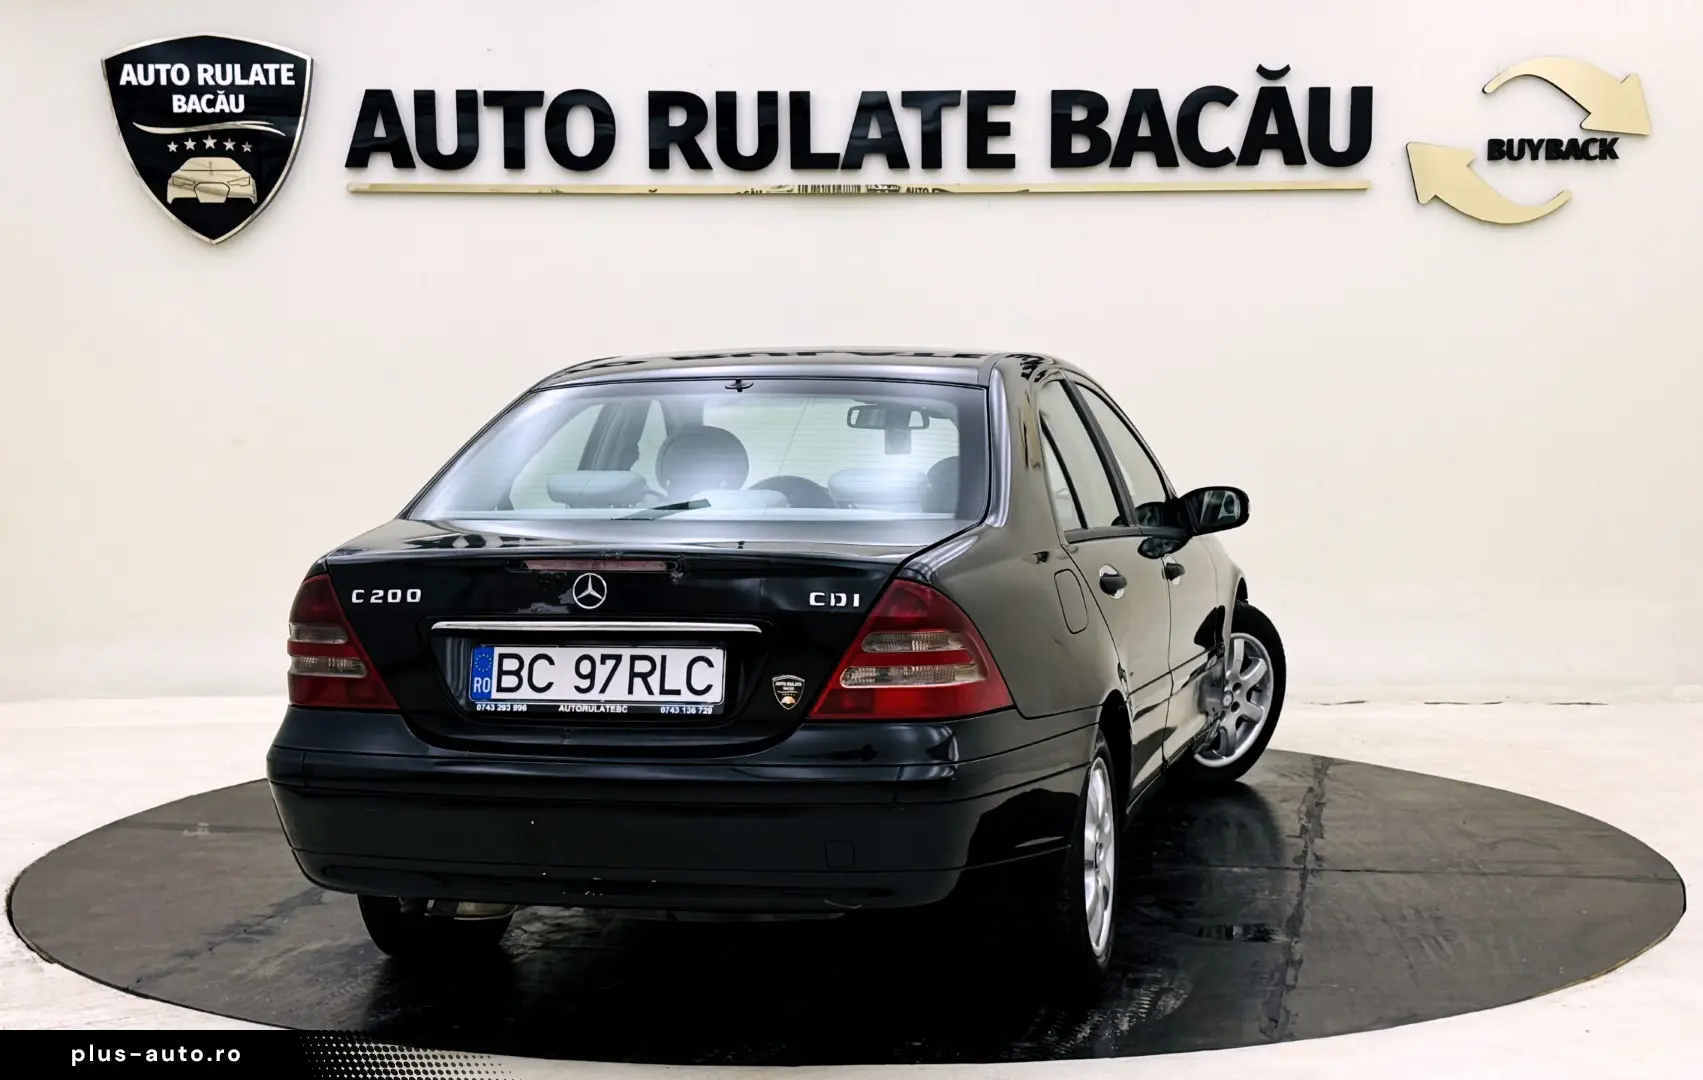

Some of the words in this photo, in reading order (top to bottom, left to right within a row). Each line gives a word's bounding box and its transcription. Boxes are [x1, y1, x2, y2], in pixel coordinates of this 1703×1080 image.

[120, 63, 190, 86] AUTO
[197, 63, 296, 86] RULATE
[172, 90, 245, 113] BACĂU
[345, 89, 616, 172] AUTO
[648, 90, 1016, 172] RULATE
[1051, 64, 1373, 169] BACĂU
[1487, 137, 1620, 161] BUYBACK
[809, 592, 860, 607] CDI
[496, 653, 555, 693] BC
[473, 677, 491, 693] RO
[558, 704, 628, 713] AUTORULATEBC
[660, 706, 680, 714] 0743
[682, 706, 697, 714] 136
[698, 706, 713, 715] 729
